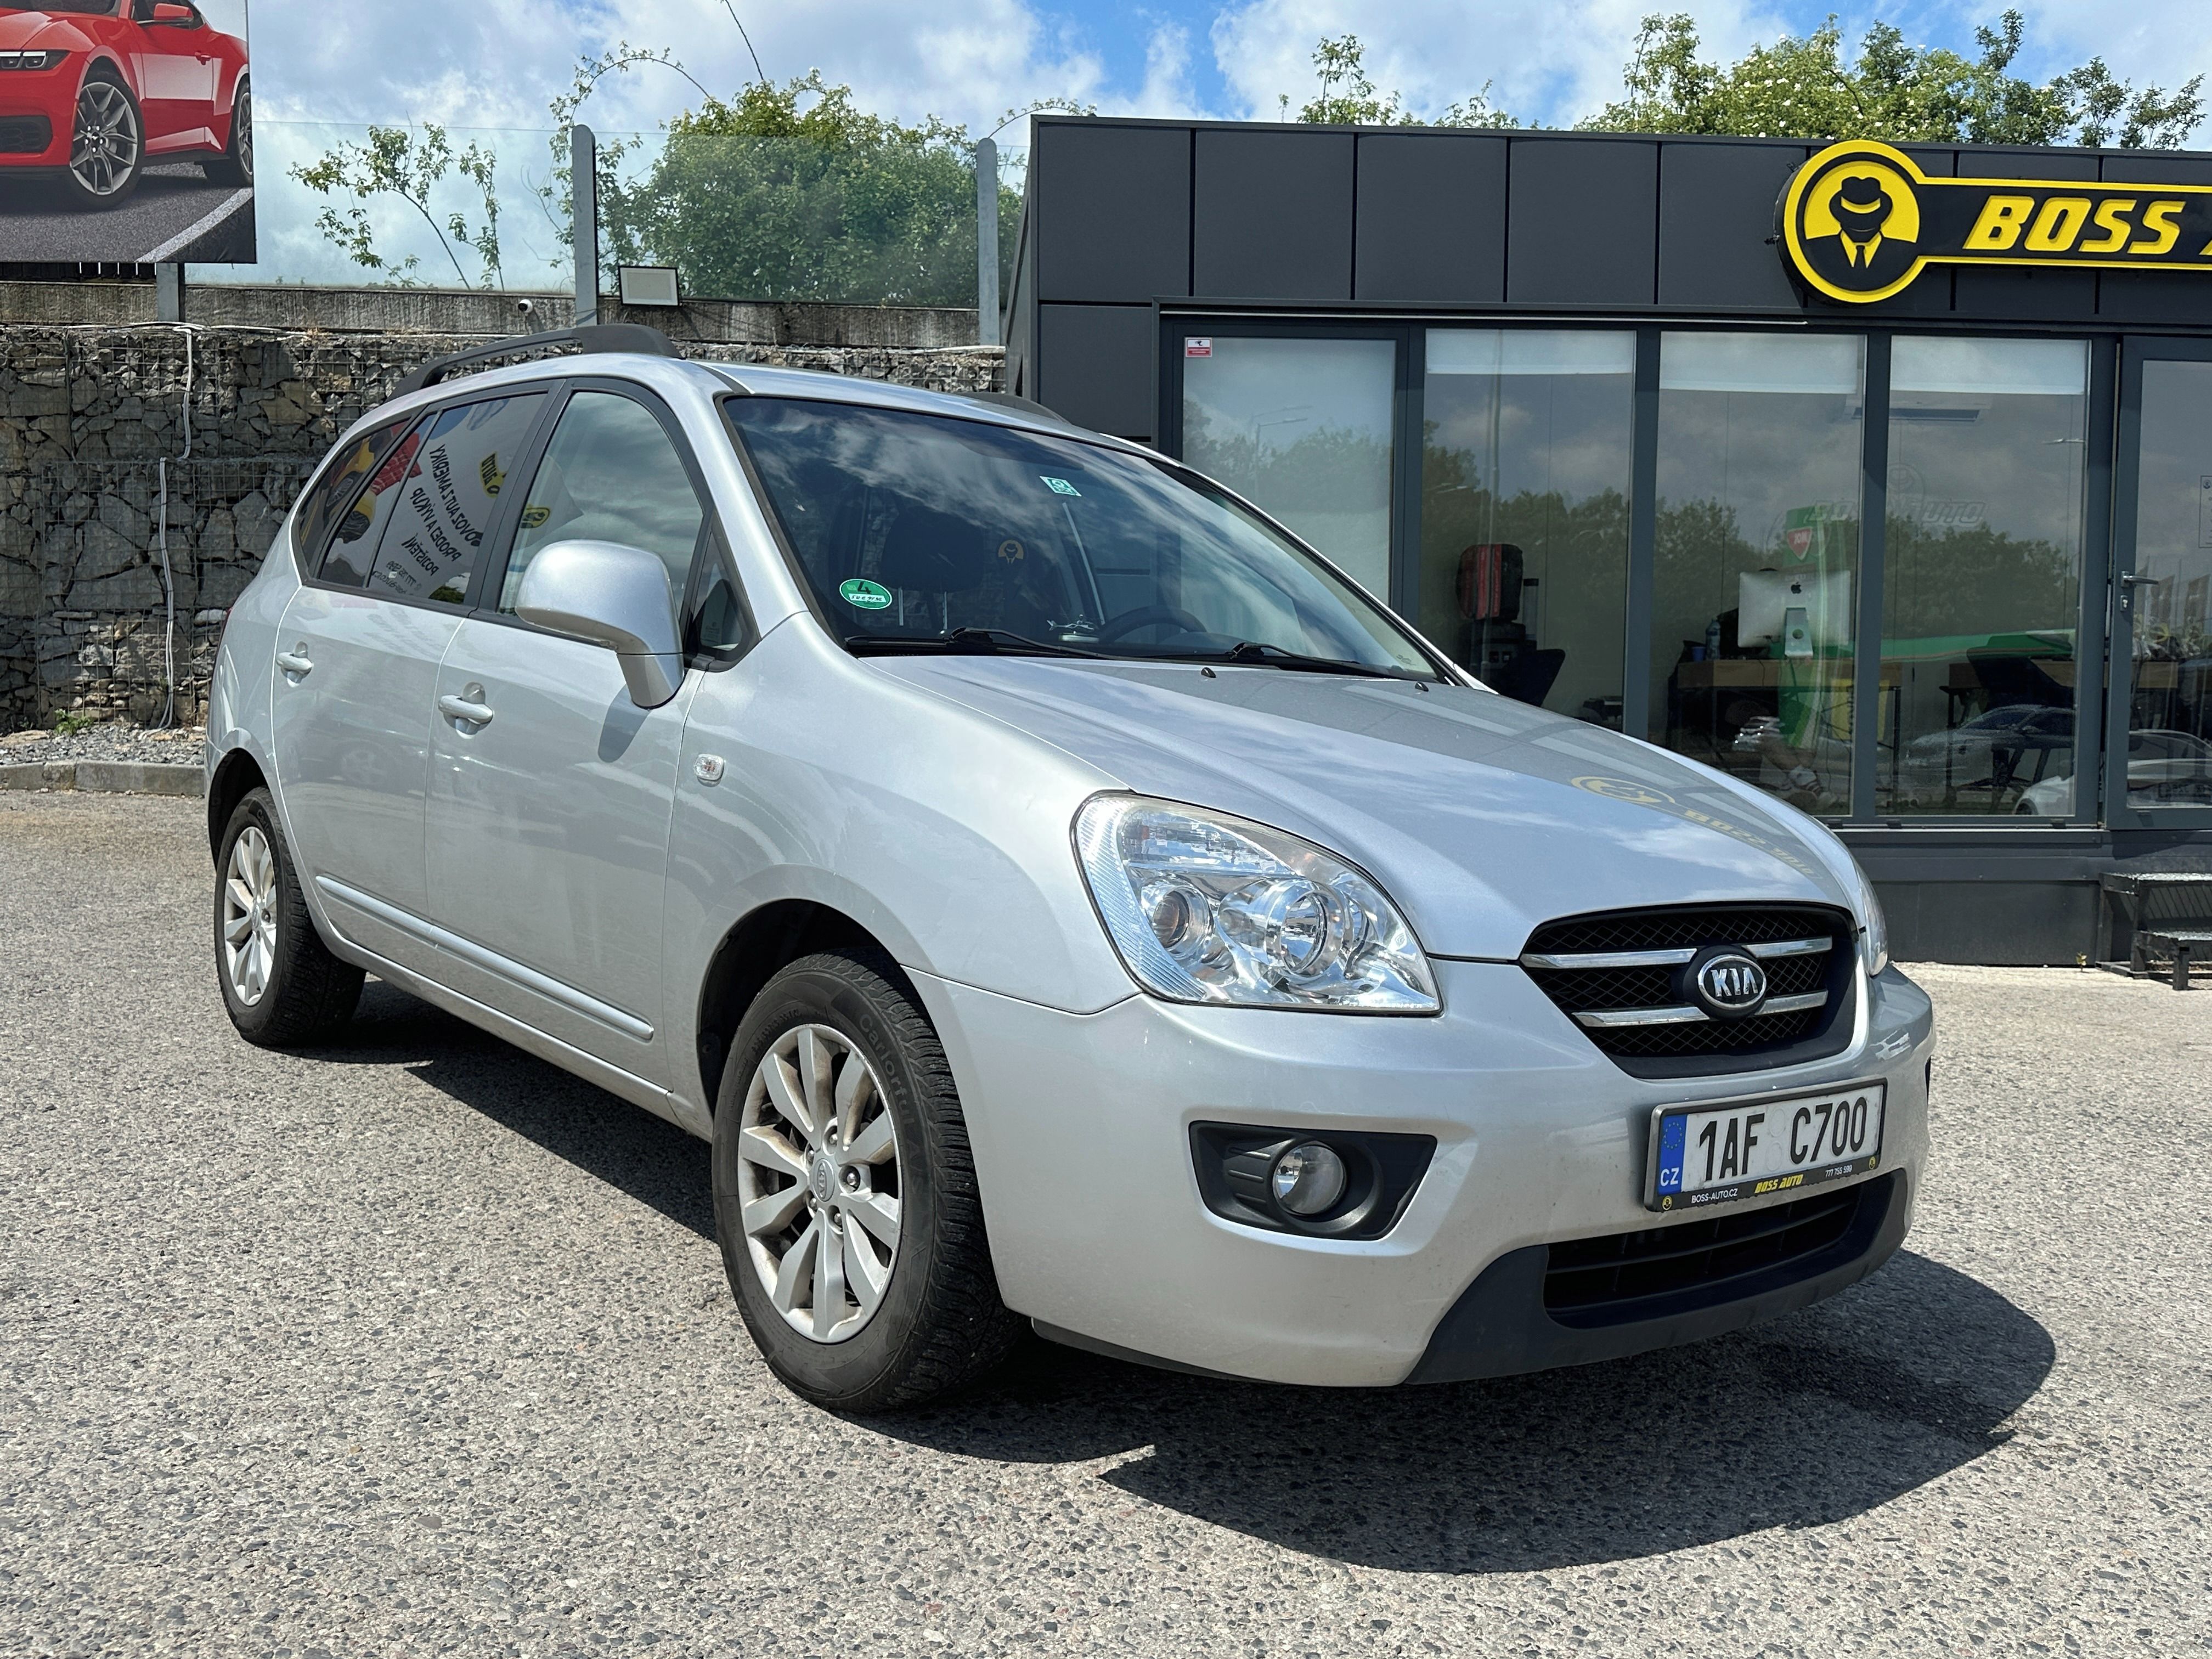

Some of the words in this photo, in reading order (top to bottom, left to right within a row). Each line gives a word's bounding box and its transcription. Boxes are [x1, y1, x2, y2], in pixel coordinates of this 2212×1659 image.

[1962, 194, 2186, 256] BOSS
[857, 581, 872, 595] 4
[1710, 967, 1759, 998] KIA
[859, 1013, 916, 1125] Carlorful
[1699, 1113, 1765, 1182] 1AF
[1790, 1096, 1868, 1165] C700
[1660, 1167, 1680, 1187] CZ
[1754, 1177, 1779, 1194] BOSS
[1778, 1173, 1804, 1190] AUTO
[1825, 1169, 1834, 1178] 777
[1691, 1188, 1739, 1204] BOSS-AUTO.CZ
